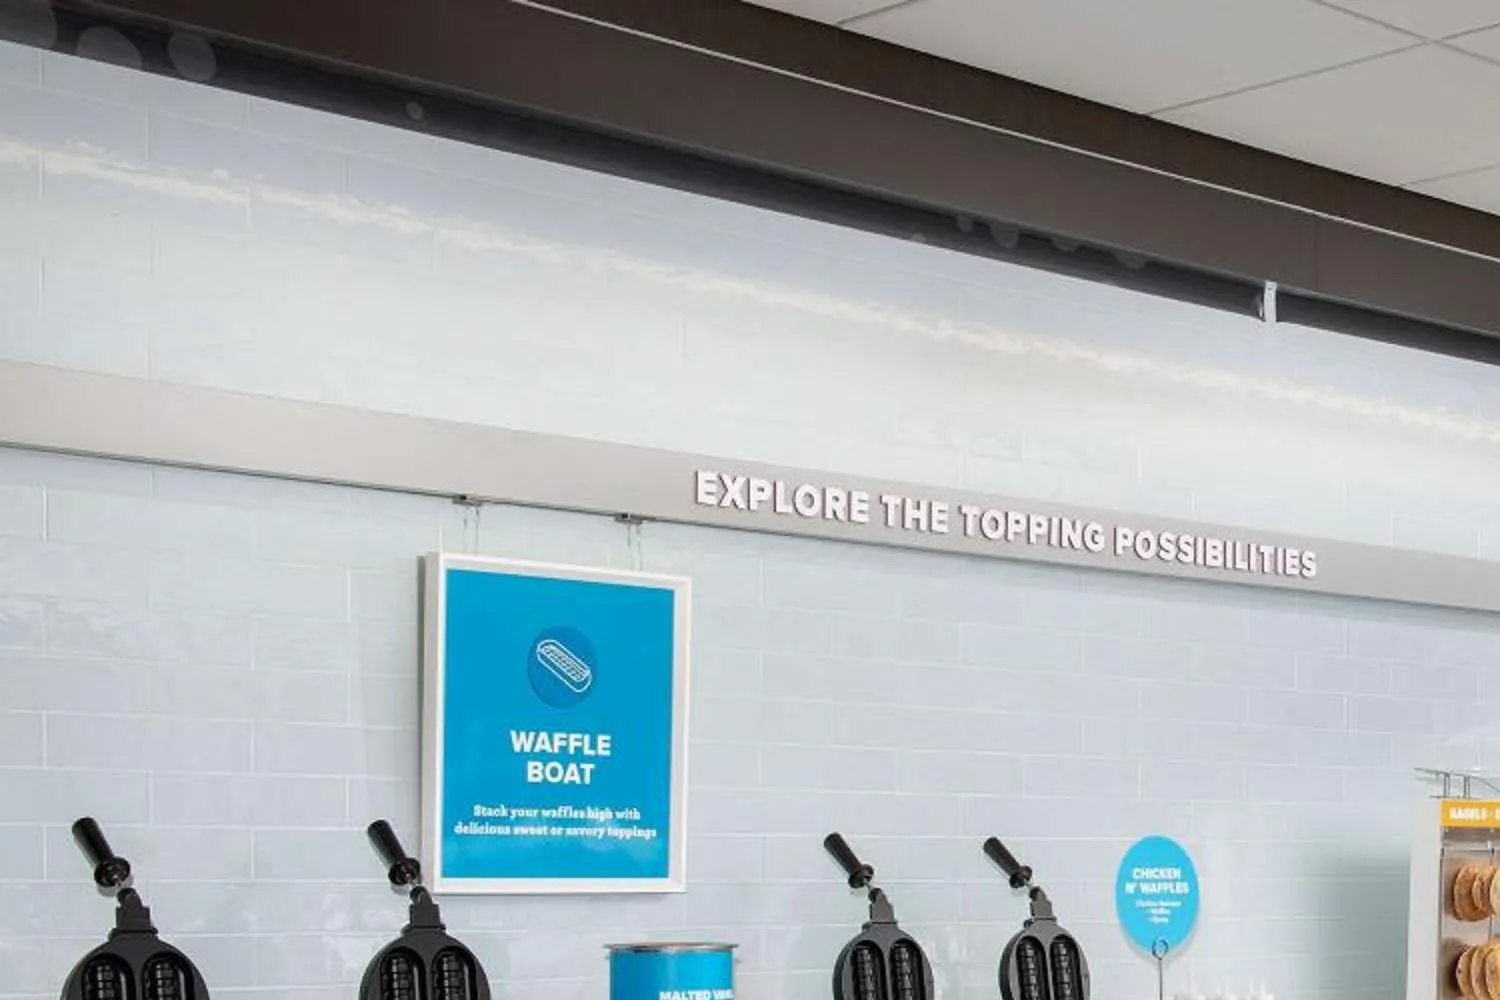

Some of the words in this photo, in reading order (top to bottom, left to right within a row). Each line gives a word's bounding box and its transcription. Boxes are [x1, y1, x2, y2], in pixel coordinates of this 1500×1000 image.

[695, 469, 871, 525] EXPLORE
[880, 494, 950, 534] THE
[957, 503, 1105, 553] TOPPING
[1113, 525, 1318, 579] POSSIBILITIES
[510, 730, 611, 756] WAFFLE
[527, 761, 595, 785] BOAT
[473, 804, 508, 817] Stack
[509, 808, 539, 820] your
[541, 805, 584, 819] waffles
[586, 805, 613, 821] high
[615, 808, 641, 820] with
[454, 820, 511, 835] delicious
[513, 824, 548, 836] sweet
[550, 827, 562, 836] or
[565, 827, 605, 839] savory
[607, 826, 657, 840] toppings
[1132, 867, 1182, 879] CHICKEN
[1139, 882, 1190, 895] WAFFLES
